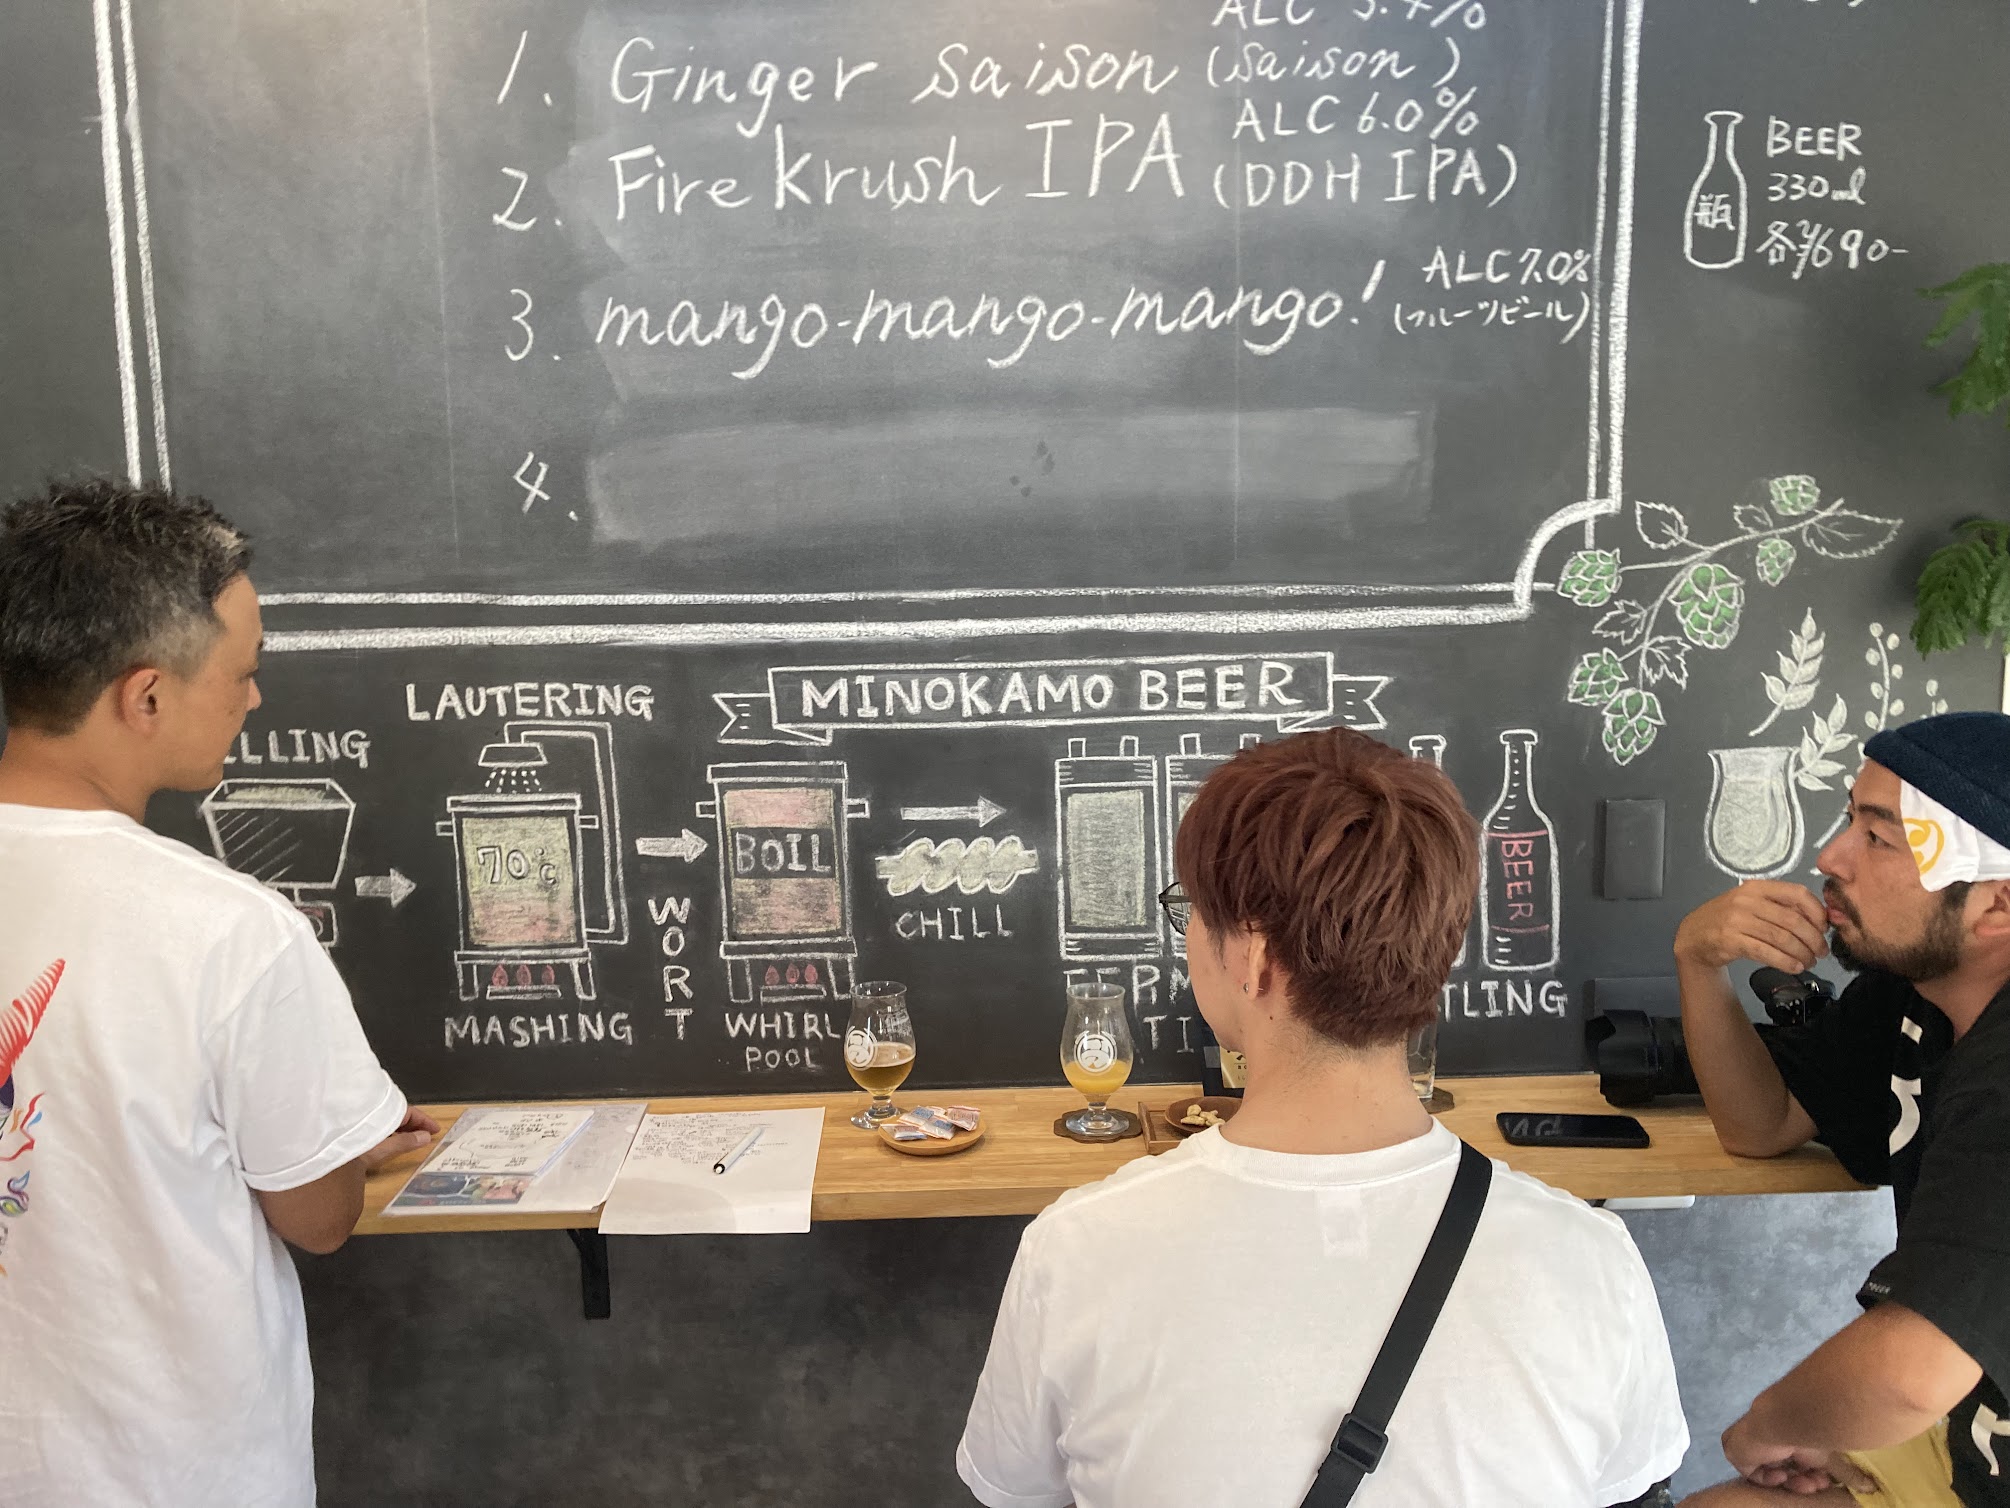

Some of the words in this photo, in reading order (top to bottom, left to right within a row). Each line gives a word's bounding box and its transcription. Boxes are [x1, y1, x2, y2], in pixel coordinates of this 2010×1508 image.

[499, 31, 552, 106] 1.
[611, 37, 879, 138] Ginger
[1231, 97, 1340, 141] ALC
[1357, 87, 1480, 139] 6.0%
[1766, 115, 1863, 161] BEER
[493, 166, 563, 231] 2.
[1025, 113, 1186, 198] IPA
[1212, 152, 1361, 208] (DDH
[1384, 144, 1518, 208] IPA)
[1421, 246, 1513, 290] ALC
[504, 288, 562, 361] 3.
[513, 452, 578, 521] 4.
[405, 682, 655, 721] LAUTERING
[802, 671, 1115, 718] MINOKAMO
[1140, 661, 1303, 711] BEER
[223, 728, 372, 769] LLING
[735, 828, 832, 875] BOIL
[1501, 839, 1534, 921] BEER
[894, 904, 1014, 942] CHILL
[444, 1011, 634, 1052] MASHING
[724, 1010, 841, 1040] WHIRL
[745, 1045, 821, 1073] POOL
